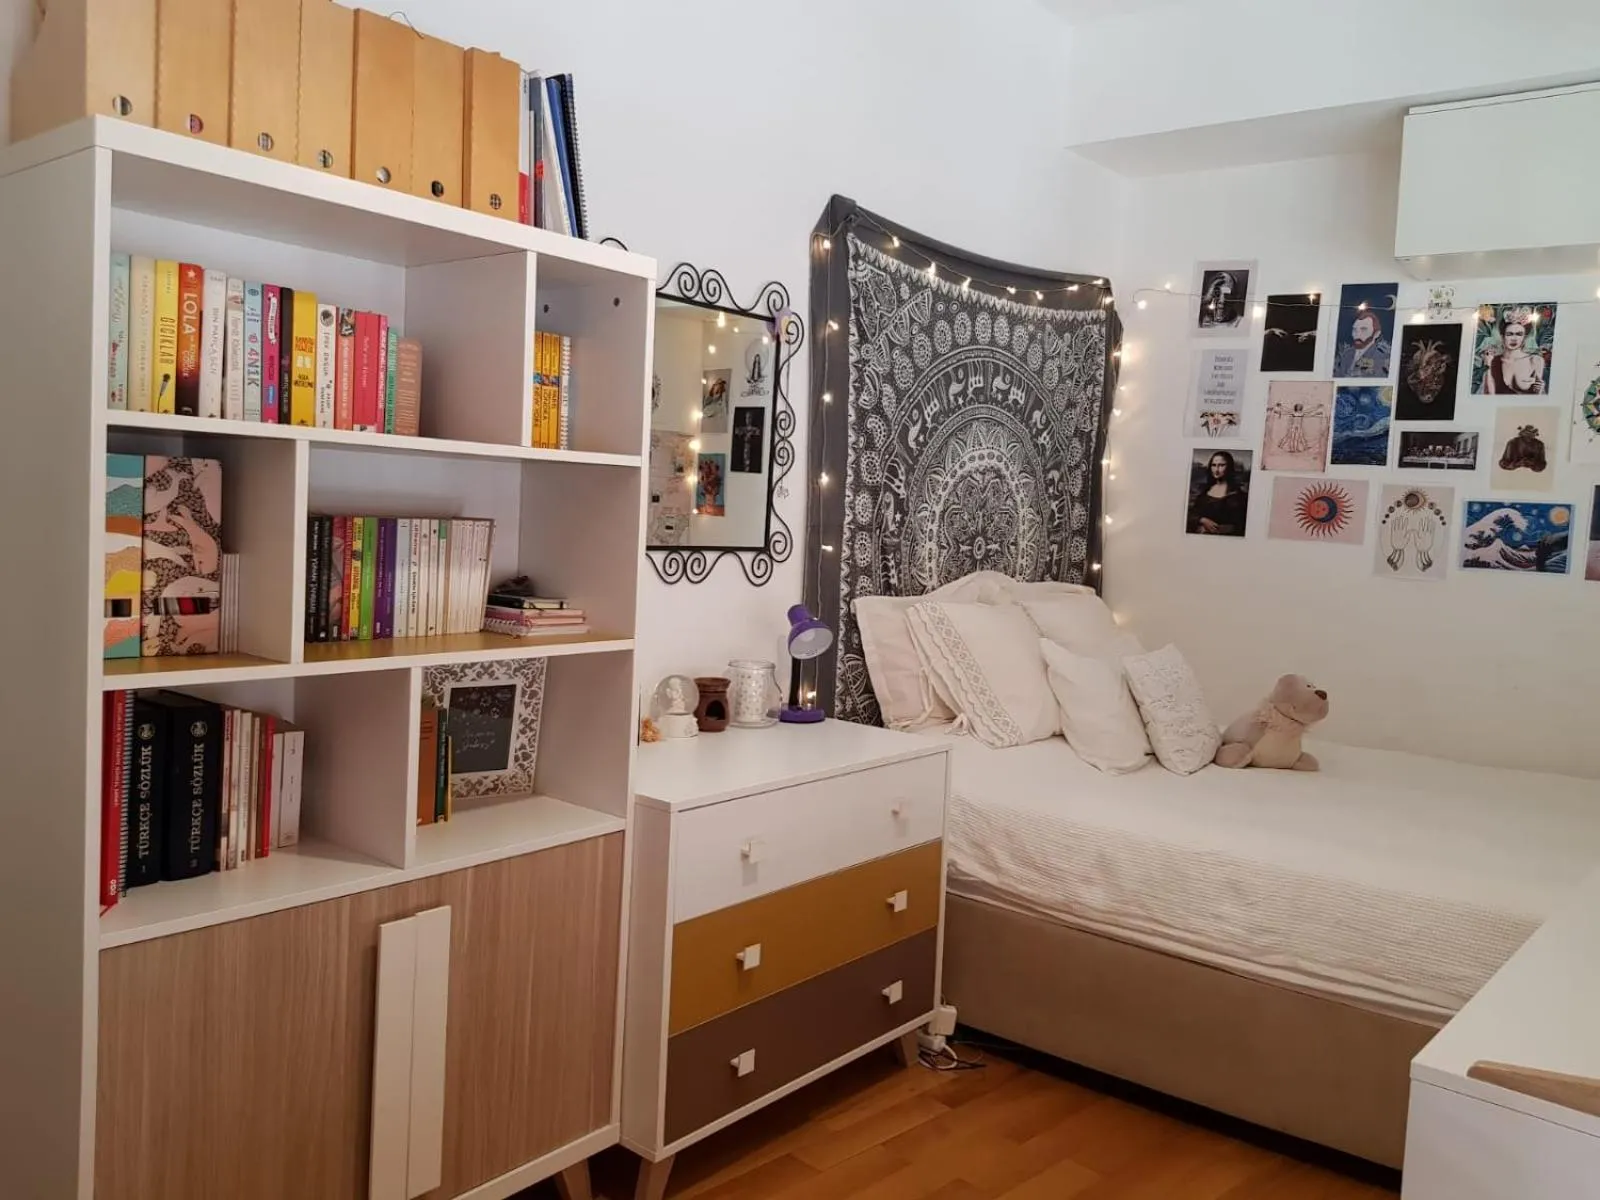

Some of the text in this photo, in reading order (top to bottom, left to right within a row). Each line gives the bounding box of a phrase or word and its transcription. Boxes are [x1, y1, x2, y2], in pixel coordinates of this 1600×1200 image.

[182, 292, 199, 335] LOLA
[247, 347, 259, 387] 4N1K
[138, 745, 153, 799] SÖZLÜK
[190, 742, 204, 795] SÖZLÜK
[137, 803, 153, 858] TÜRKÇE
[189, 798, 204, 853] TÜRKÇE
